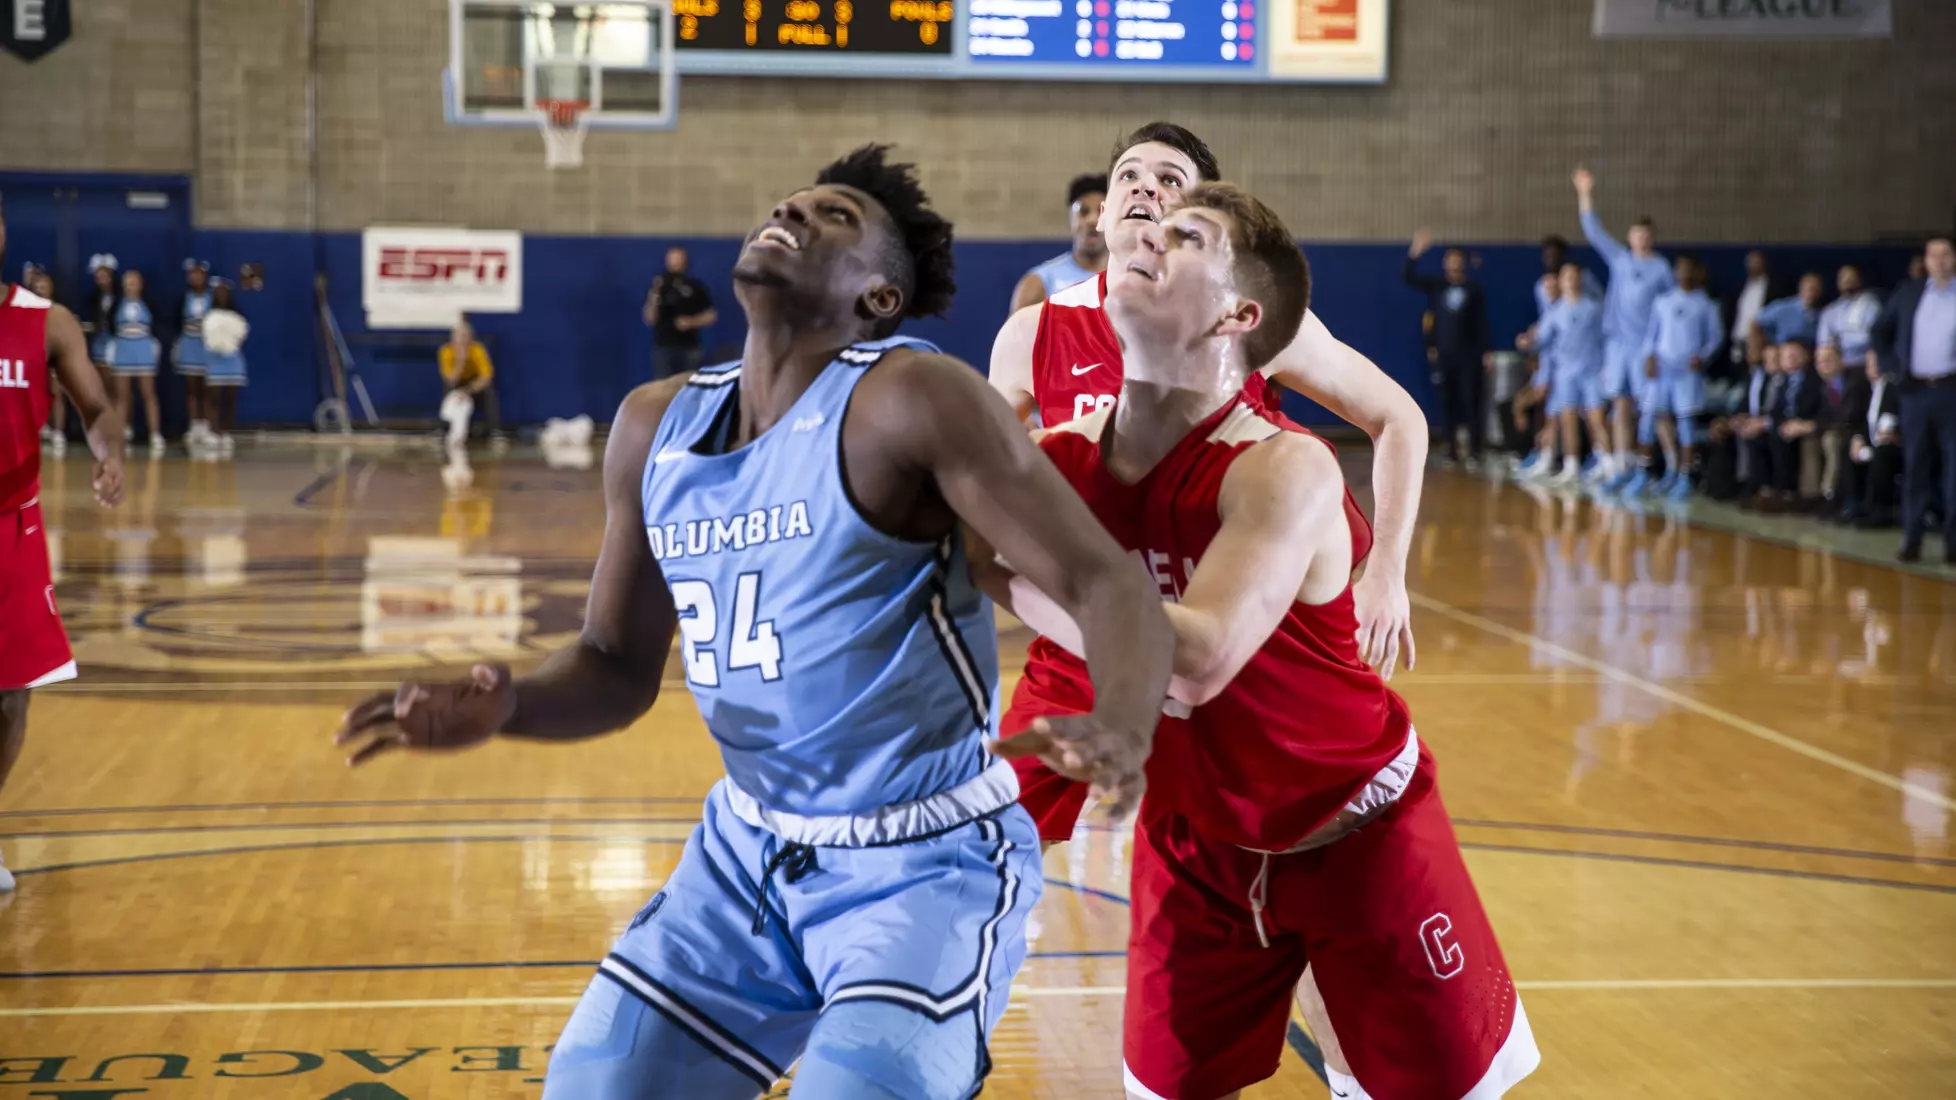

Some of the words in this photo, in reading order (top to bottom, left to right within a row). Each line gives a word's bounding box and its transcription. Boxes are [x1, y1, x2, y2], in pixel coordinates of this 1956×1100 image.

[380, 248, 508, 281] ESPN
[647, 500, 812, 560] OLUMBIA
[671, 570, 784, 688] 24
[1419, 912, 1464, 979] C
[0, 1045, 556, 1084] EAGUE
